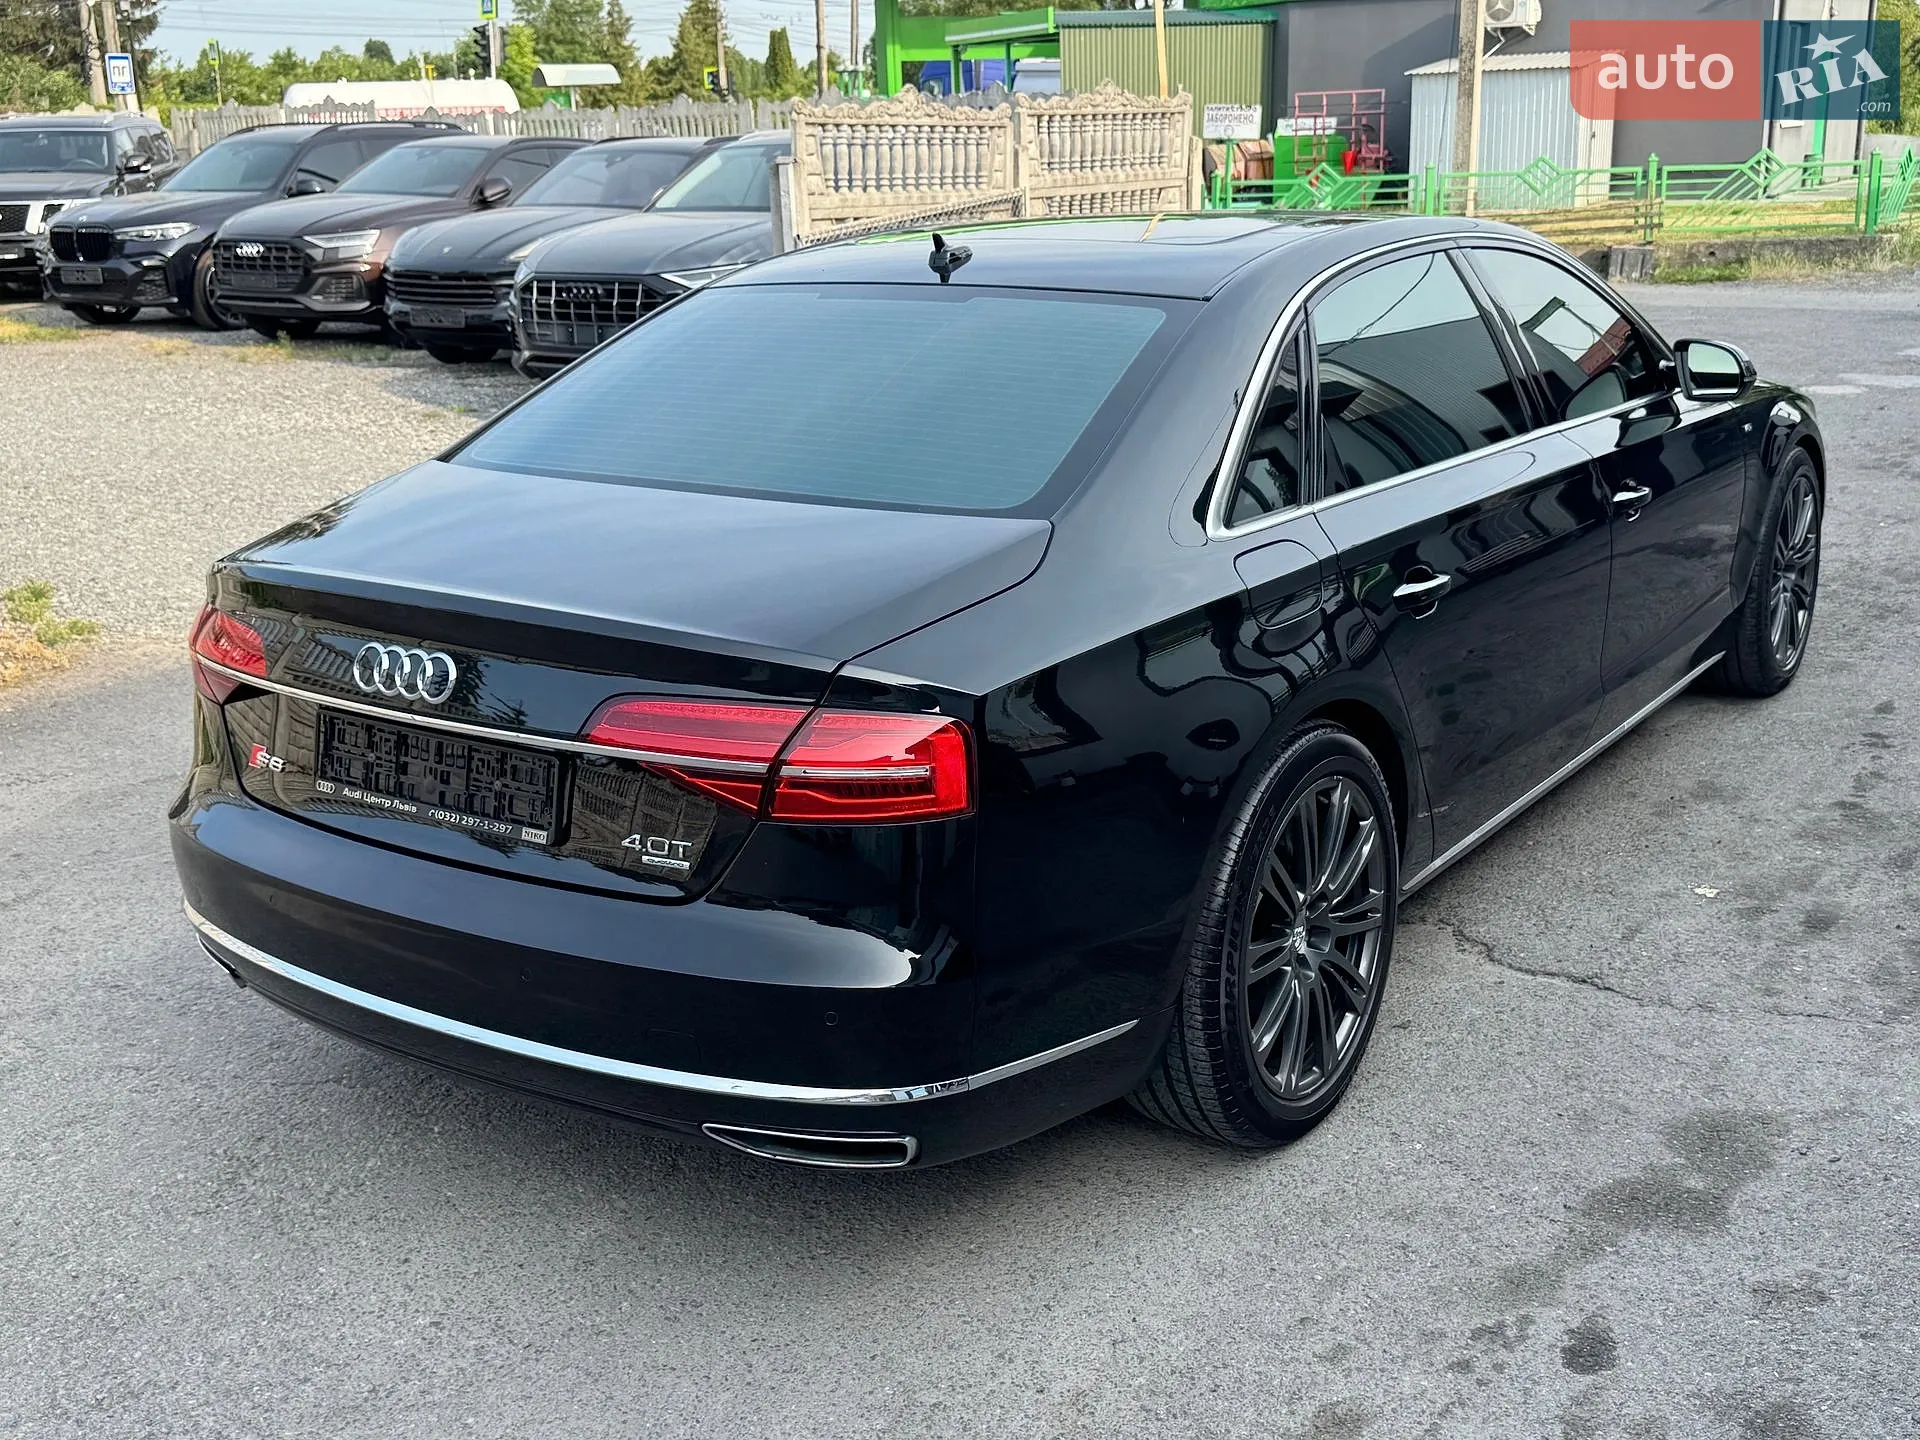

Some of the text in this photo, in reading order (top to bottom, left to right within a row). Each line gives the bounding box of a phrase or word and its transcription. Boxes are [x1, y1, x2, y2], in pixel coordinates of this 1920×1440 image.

[253, 747, 285, 772] S8
[342, 787, 417, 813] Audi Центр Львів
[435, 809, 513, 834] (032) 297-1-297
[523, 829, 546, 841] NIKO
[621, 833, 693, 858] 4.0T
